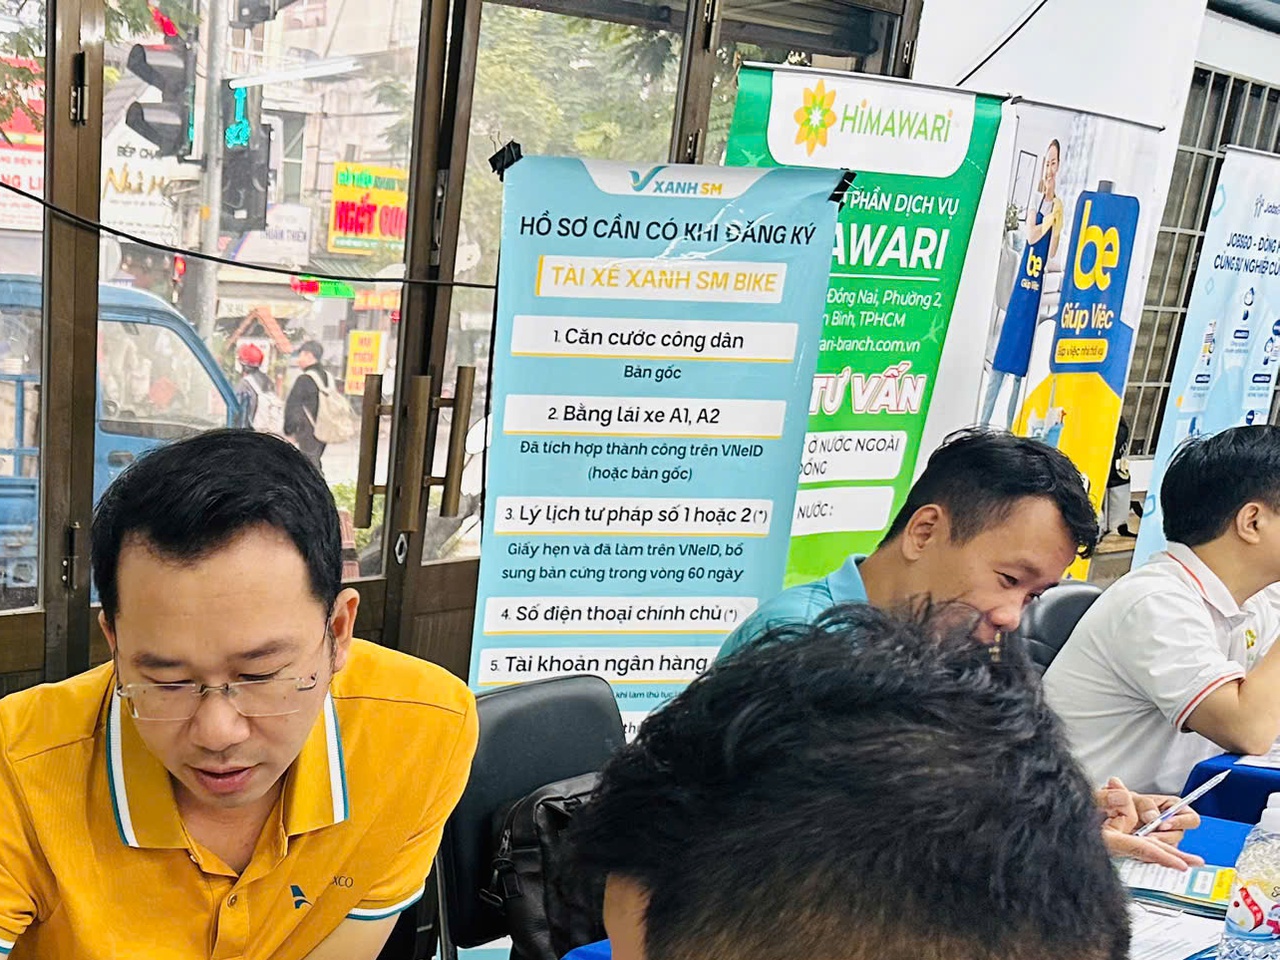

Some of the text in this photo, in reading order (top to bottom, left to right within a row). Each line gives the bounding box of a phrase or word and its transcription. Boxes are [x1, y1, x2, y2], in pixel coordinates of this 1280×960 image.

[652, 181, 722, 195] XANH SM
[850, 186, 959, 220] PHẦN DỊCH VỤ
[520, 212, 816, 244] HỒ SƠ CẦN CÓ KHI ĐĂNG KÝ
[832, 222, 950, 270] AWARI
[1073, 200, 1120, 291] be
[1026, 247, 1042, 278] be
[552, 265, 777, 291] TÀI XẾ XANH SM BIKE
[857, 289, 879, 307] Nai,
[882, 289, 932, 310] Phường
[859, 312, 906, 327] TPHCM
[1061, 302, 1114, 335] Giúp Việc
[565, 328, 602, 344] Căn
[608, 331, 656, 346] cước
[661, 331, 705, 352] công
[710, 332, 743, 348] dân
[624, 365, 681, 382] Bản gốc
[808, 360, 927, 415] TƯ VẤN
[563, 405, 612, 426] Bằng
[617, 406, 639, 422] lái
[644, 411, 664, 422] xe
[669, 408, 691, 424] A1,
[696, 408, 719, 423] A2
[520, 441, 763, 459] Đã tích hợp thành công trên VNeID
[855, 434, 900, 451] NGOÀI
[588, 466, 692, 483] (hoặc bản gốc)
[520, 505, 541, 525] Lý
[546, 505, 579, 523] lịch
[584, 507, 606, 521] tư
[607, 507, 653, 526] pháp
[658, 507, 678, 521] số
[685, 507, 689, 521] 1
[694, 507, 736, 522] hoặc
[741, 508, 751, 522] 2
[508, 543, 743, 558] Giấy hẹn và đã làm trên VNeID, bổ
[502, 566, 743, 582] sung bản cứng trong vòng 60 ngày
[516, 606, 538, 620] Số
[544, 606, 581, 623] điện
[587, 606, 632, 620] thoại
[636, 606, 684, 620] chính
[690, 606, 721, 620] chủ
[506, 656, 532, 671] Tài
[538, 655, 598, 675] khoản
[605, 655, 653, 675] ngân
[659, 655, 710, 675] hàng
